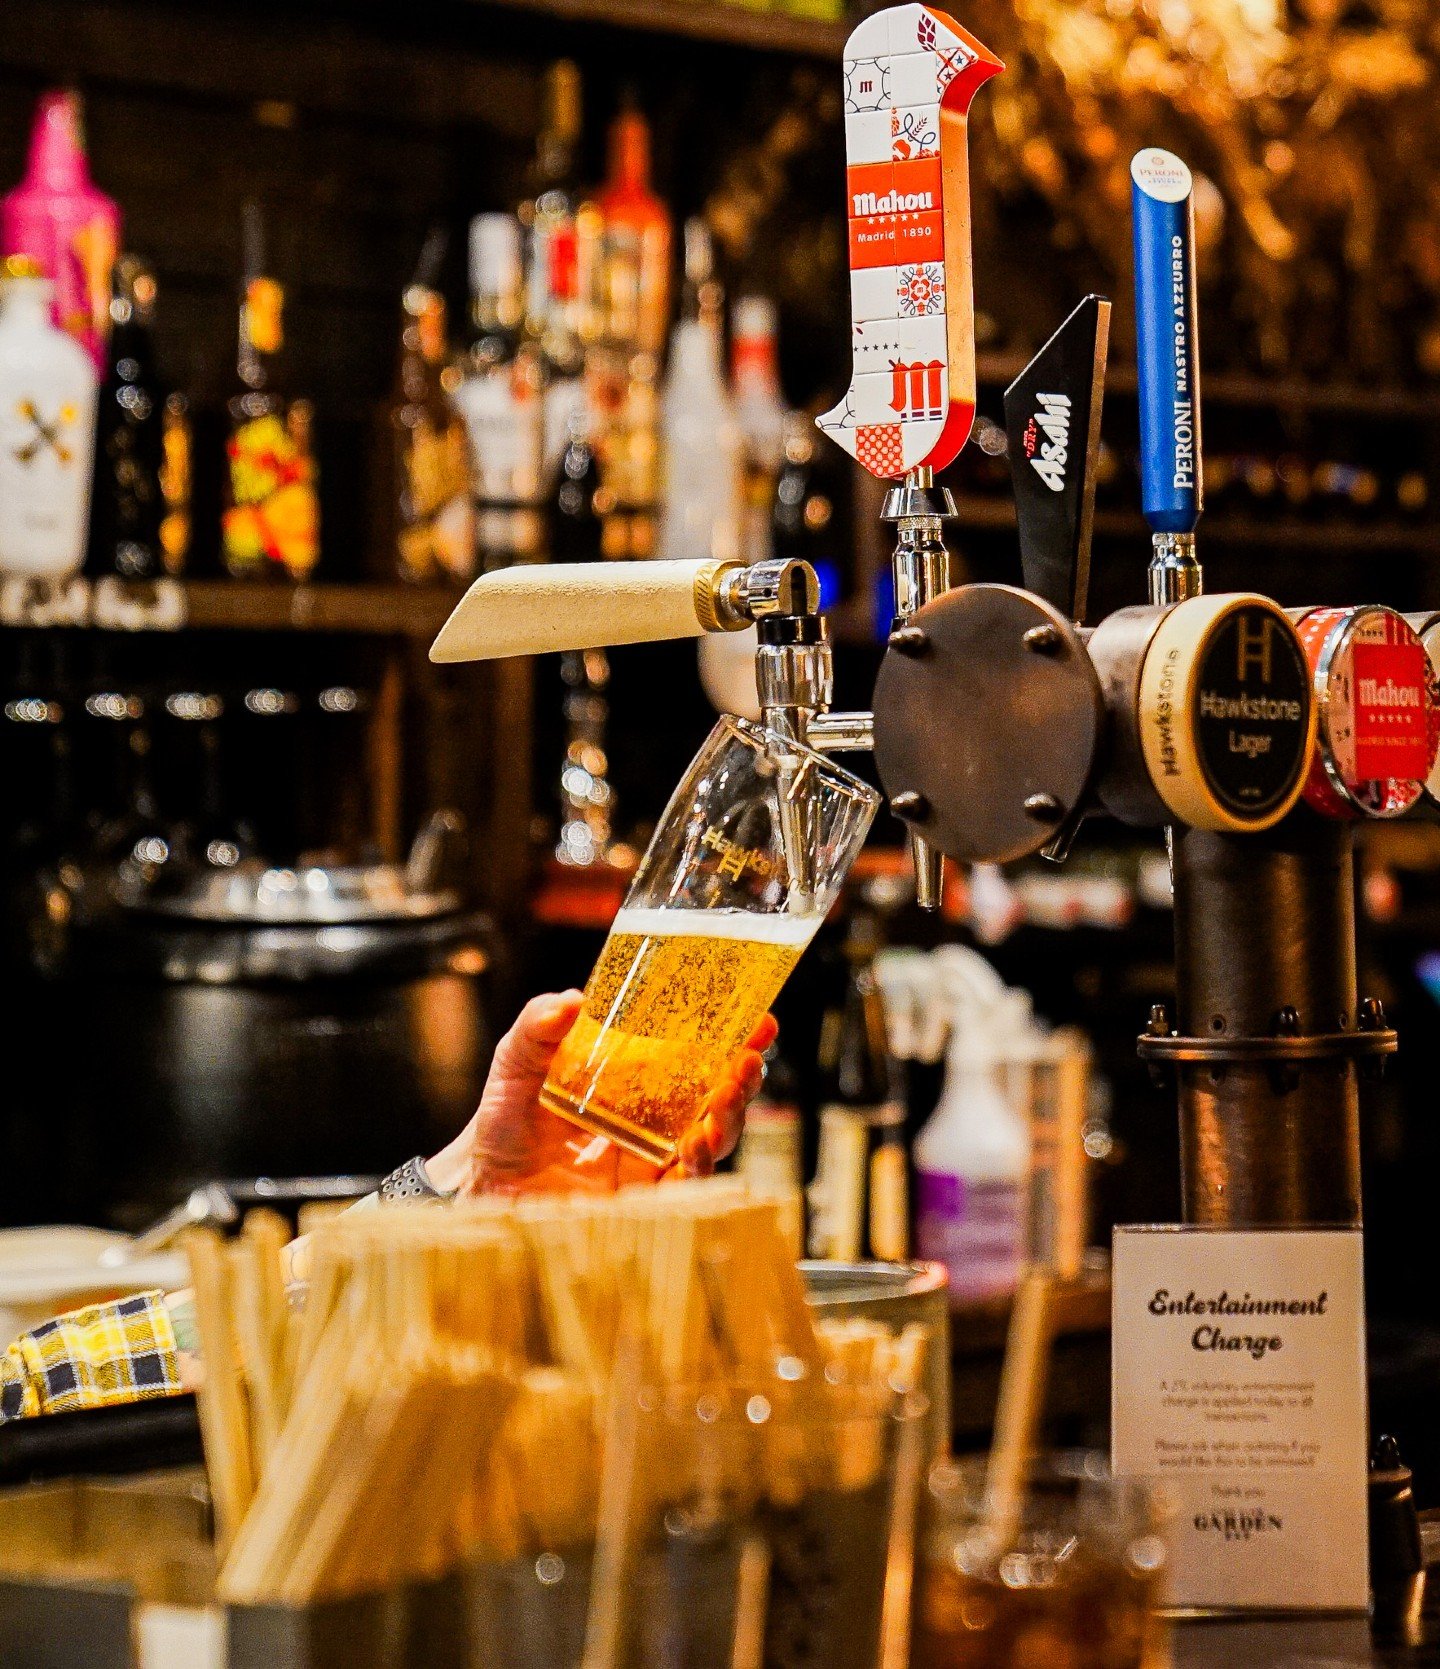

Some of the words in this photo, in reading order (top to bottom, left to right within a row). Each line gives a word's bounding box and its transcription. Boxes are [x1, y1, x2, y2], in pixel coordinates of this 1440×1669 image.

[852, 189, 933, 217] Mahou
[857, 231, 895, 243] Madrid
[903, 226, 932, 238] 1890
[1172, 235, 1185, 318] AZZURRO
[1174, 321, 1188, 392] NASTRO
[1029, 392, 1072, 492] Asahi
[1173, 399, 1194, 490] PERONI
[1200, 690, 1301, 721] Hawkstone
[1359, 678, 1420, 707] Mahou
[1155, 648, 1182, 777] Hawkstone
[1229, 730, 1272, 758] Lager
[1148, 1289, 1327, 1316] Entertainment
[1191, 1324, 1283, 1360] Charge
[1193, 1512, 1283, 1532] GARDEN
